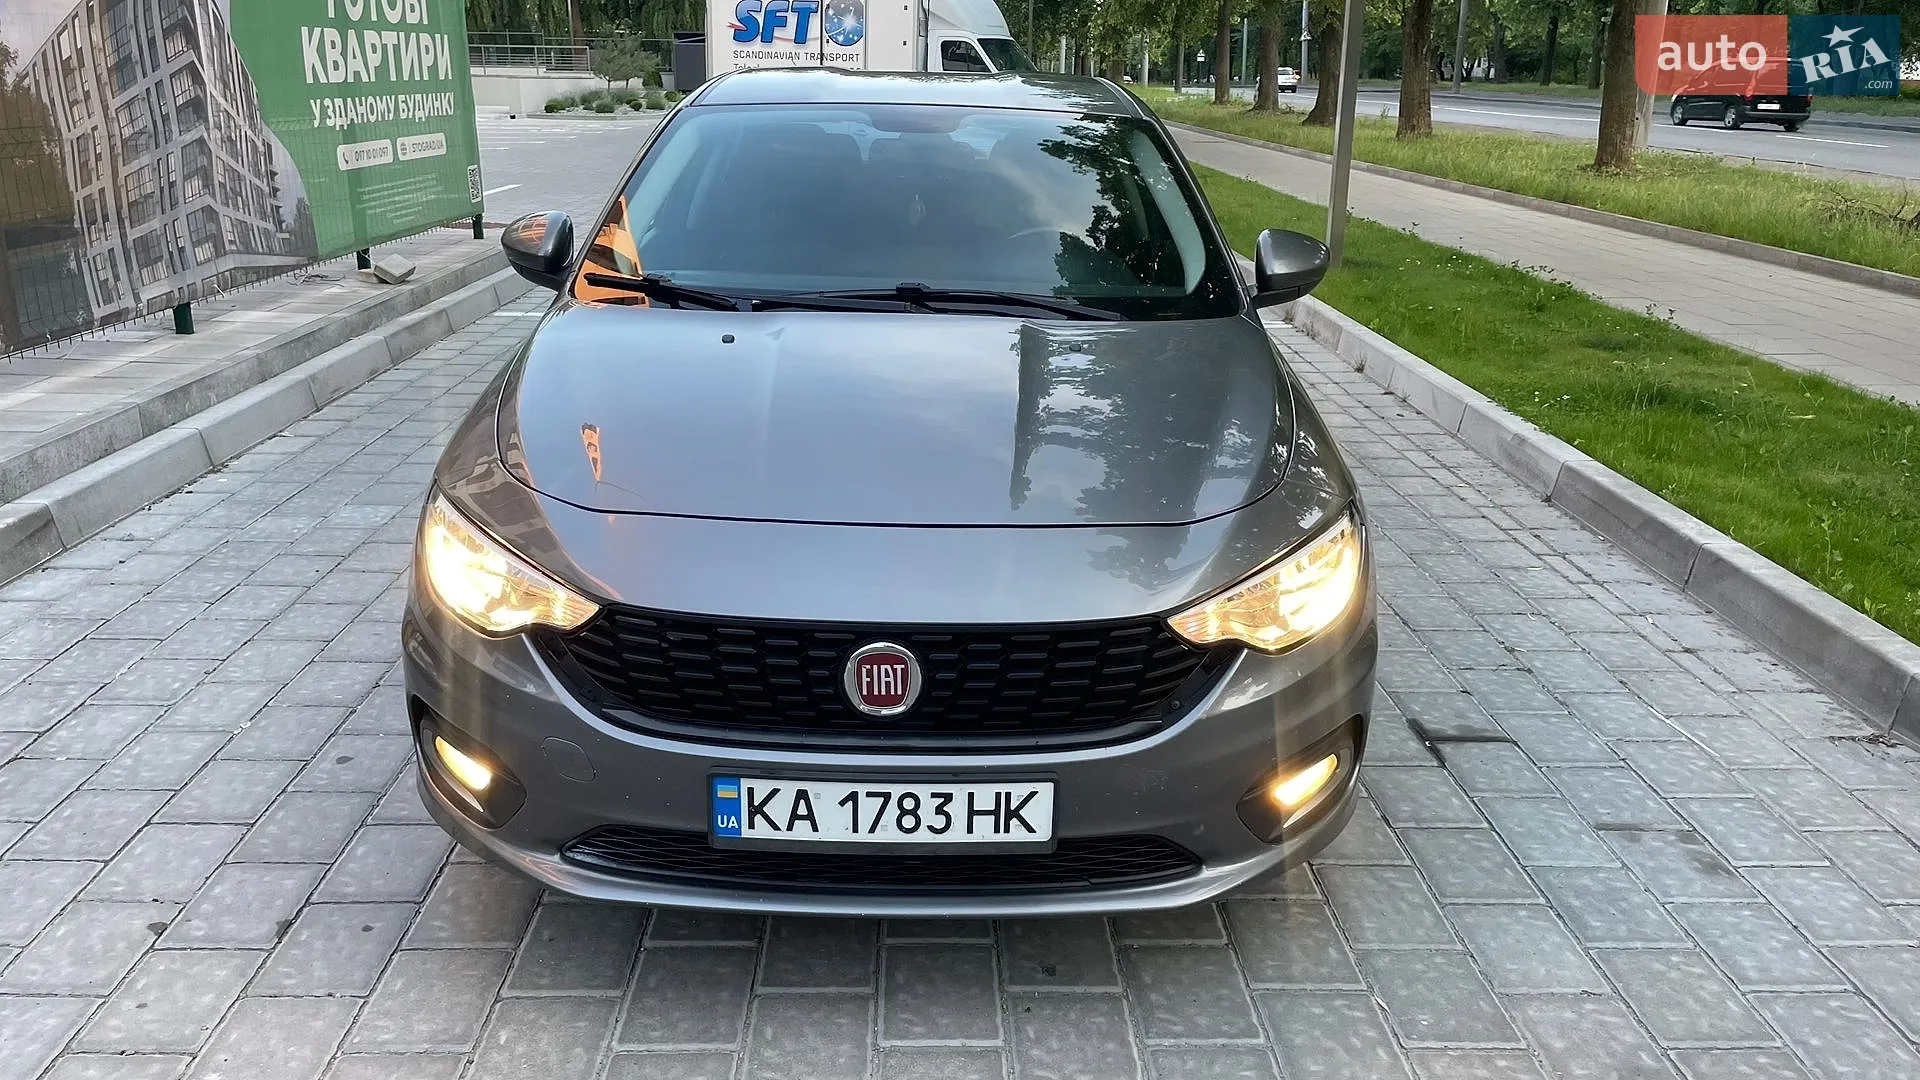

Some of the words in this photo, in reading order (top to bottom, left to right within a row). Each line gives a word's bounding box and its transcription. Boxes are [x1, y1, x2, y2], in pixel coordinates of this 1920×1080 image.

[733, 0, 819, 44] SFT
[301, 26, 452, 84] КВАРТИРИ
[733, 50, 800, 61] SCANDINAVIAN
[804, 52, 860, 62] TRANSPORT
[309, 99, 321, 128] У
[323, 95, 395, 131] ЗДАНОМУ
[397, 91, 455, 123] БУДИНКУ
[861, 664, 906, 696] FIAT
[717, 815, 739, 829] UA
[746, 786, 820, 833] KA
[837, 790, 954, 835] 1783
[966, 790, 1039, 835] HK
